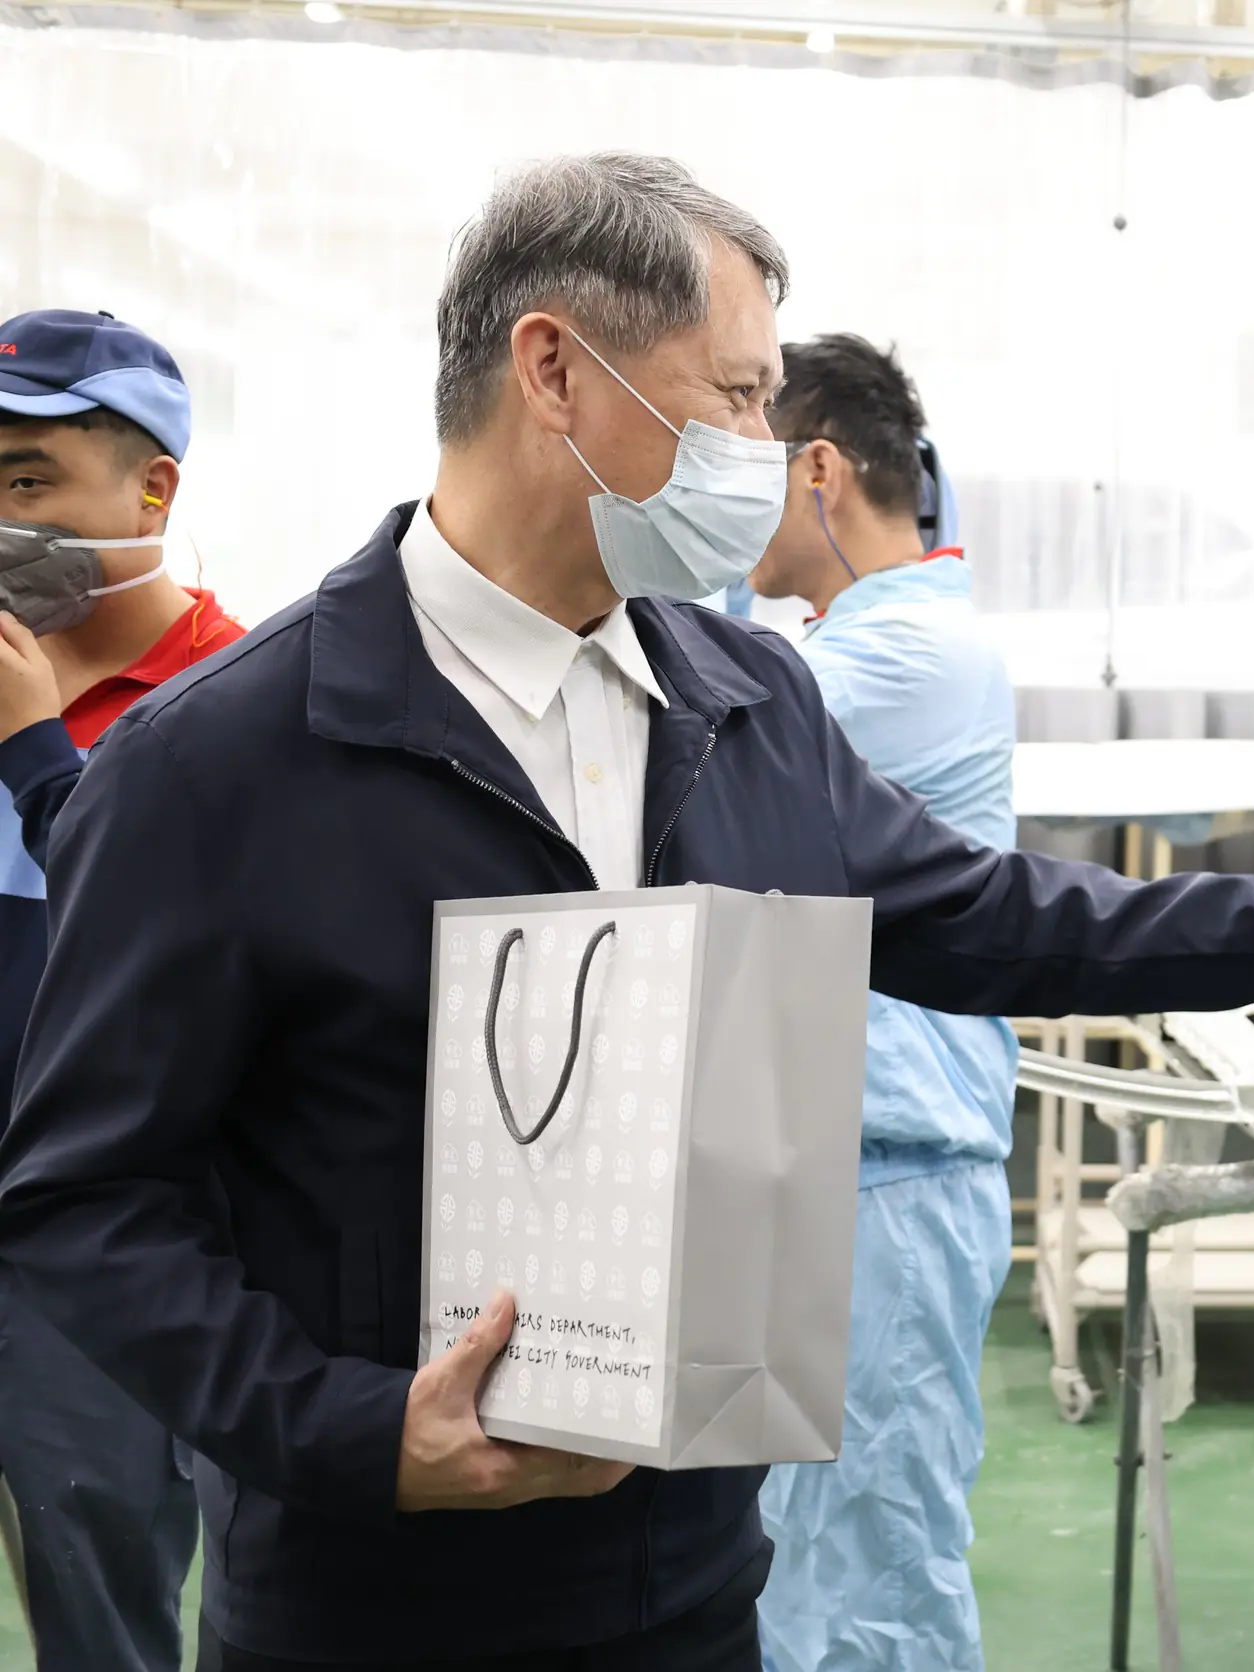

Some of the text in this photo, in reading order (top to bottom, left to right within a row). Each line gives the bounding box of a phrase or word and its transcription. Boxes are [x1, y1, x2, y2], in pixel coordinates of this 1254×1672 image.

[444, 1306, 636, 1344] LABOR AIRS DEPARTMENT,
[527, 1348, 558, 1369] CITY
[565, 1350, 651, 1381] GOVERNMENT
